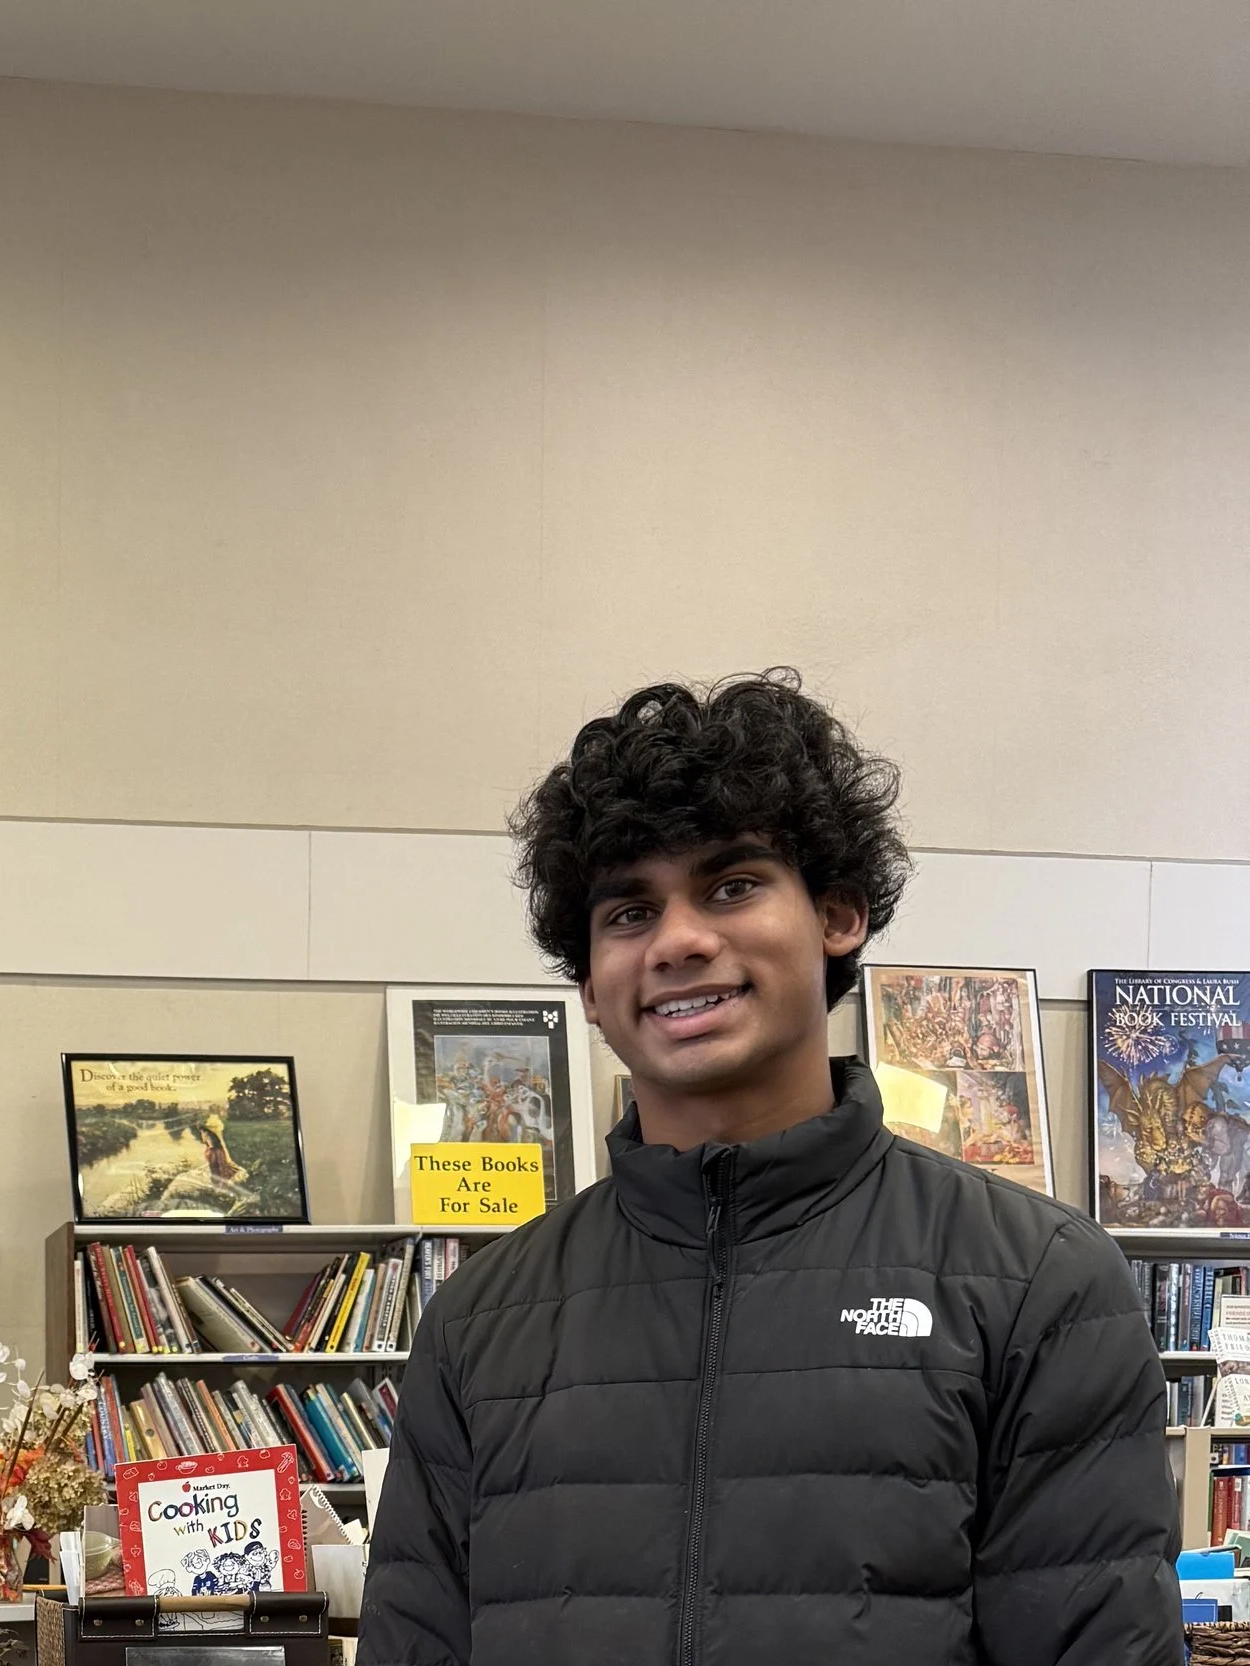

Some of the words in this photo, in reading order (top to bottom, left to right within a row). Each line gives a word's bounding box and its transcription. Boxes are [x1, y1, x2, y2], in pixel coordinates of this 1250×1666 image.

[1115, 985, 1240, 1006] NATIONAL
[1115, 1012, 1164, 1027] BOOK
[1171, 1012, 1242, 1028] FESTIVAL
[129, 1072, 144, 1081] the
[414, 1156, 471, 1172] These
[482, 1157, 539, 1172] Books
[457, 1177, 491, 1192] Are
[439, 1198, 470, 1213] For
[480, 1198, 519, 1213] Sale
[870, 1297, 904, 1311] THE
[840, 1309, 902, 1323] NORTH
[855, 1321, 899, 1336] FACE
[148, 1493, 239, 1521] Cooking
[173, 1519, 204, 1537] with
[208, 1517, 261, 1548] KIDS
